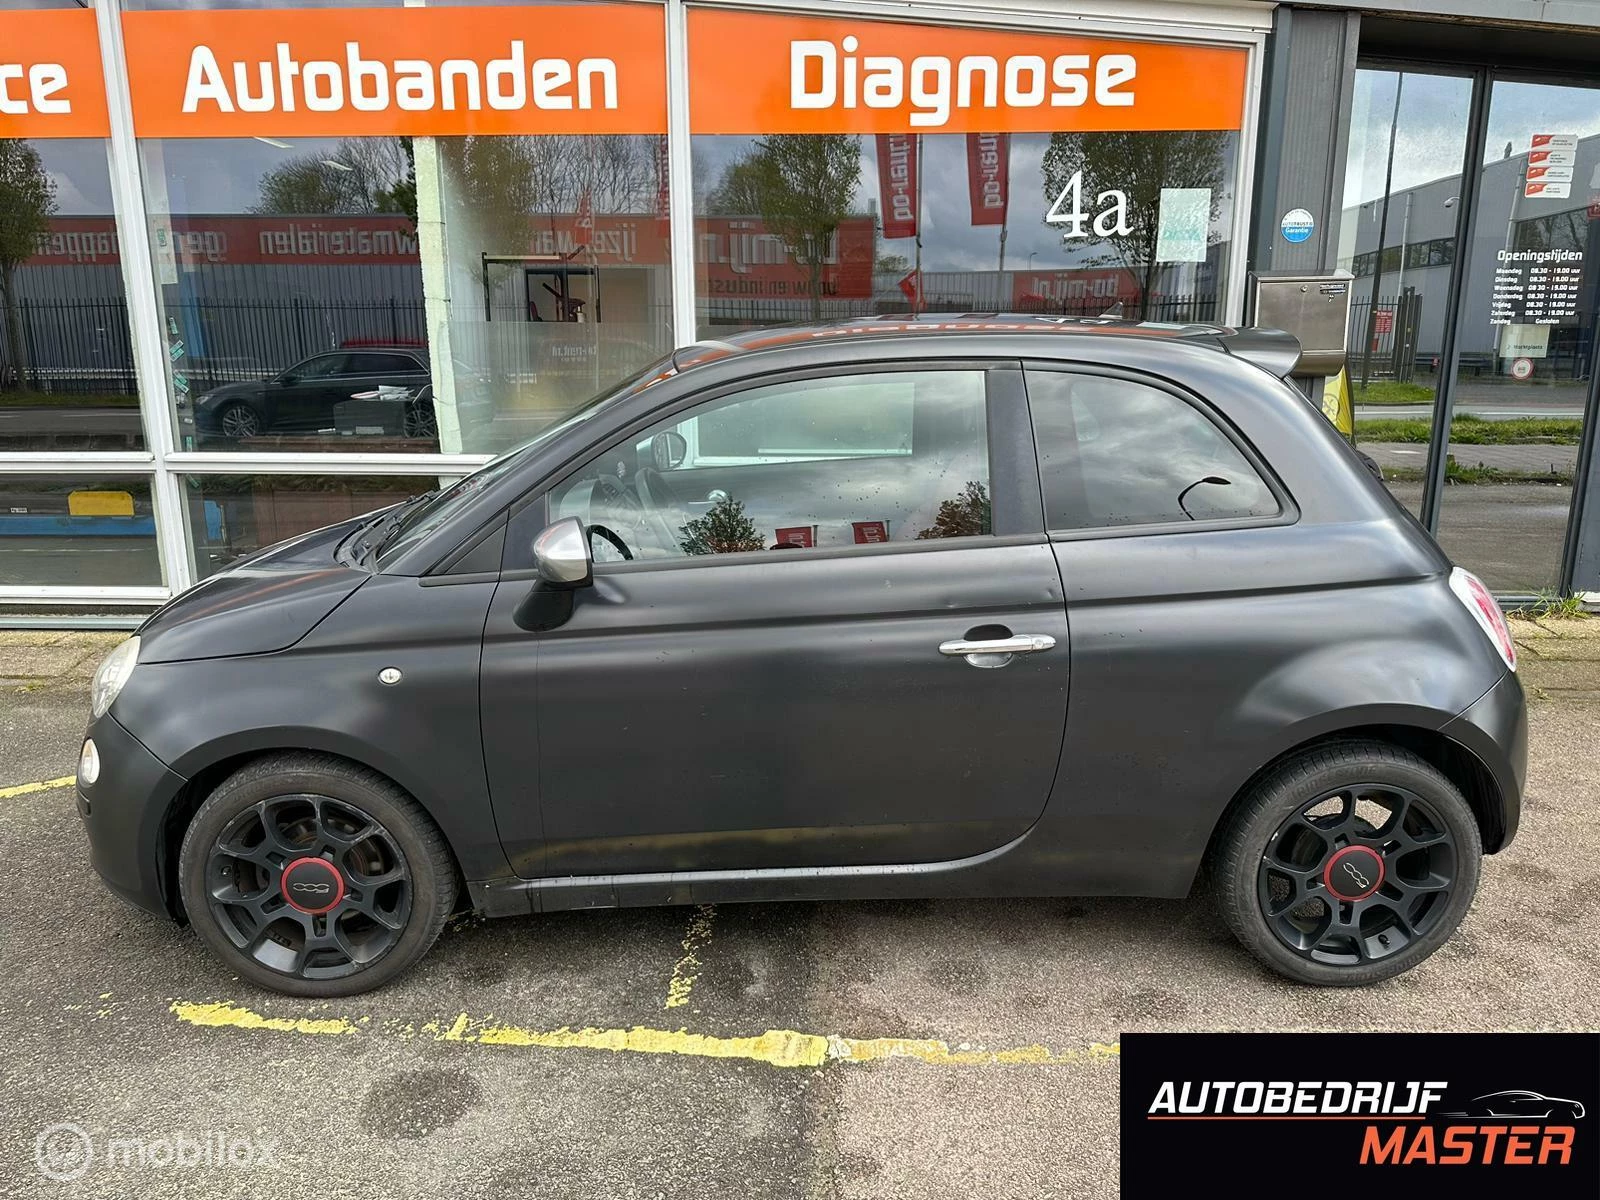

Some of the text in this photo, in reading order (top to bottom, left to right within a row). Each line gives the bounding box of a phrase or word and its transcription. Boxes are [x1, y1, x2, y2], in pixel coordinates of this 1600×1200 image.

[182, 40, 619, 114] Autobanden
[790, 36, 1137, 127] Diagnose
[1046, 171, 1134, 239] 4a
[1497, 249, 1583, 263] Openingstijden
